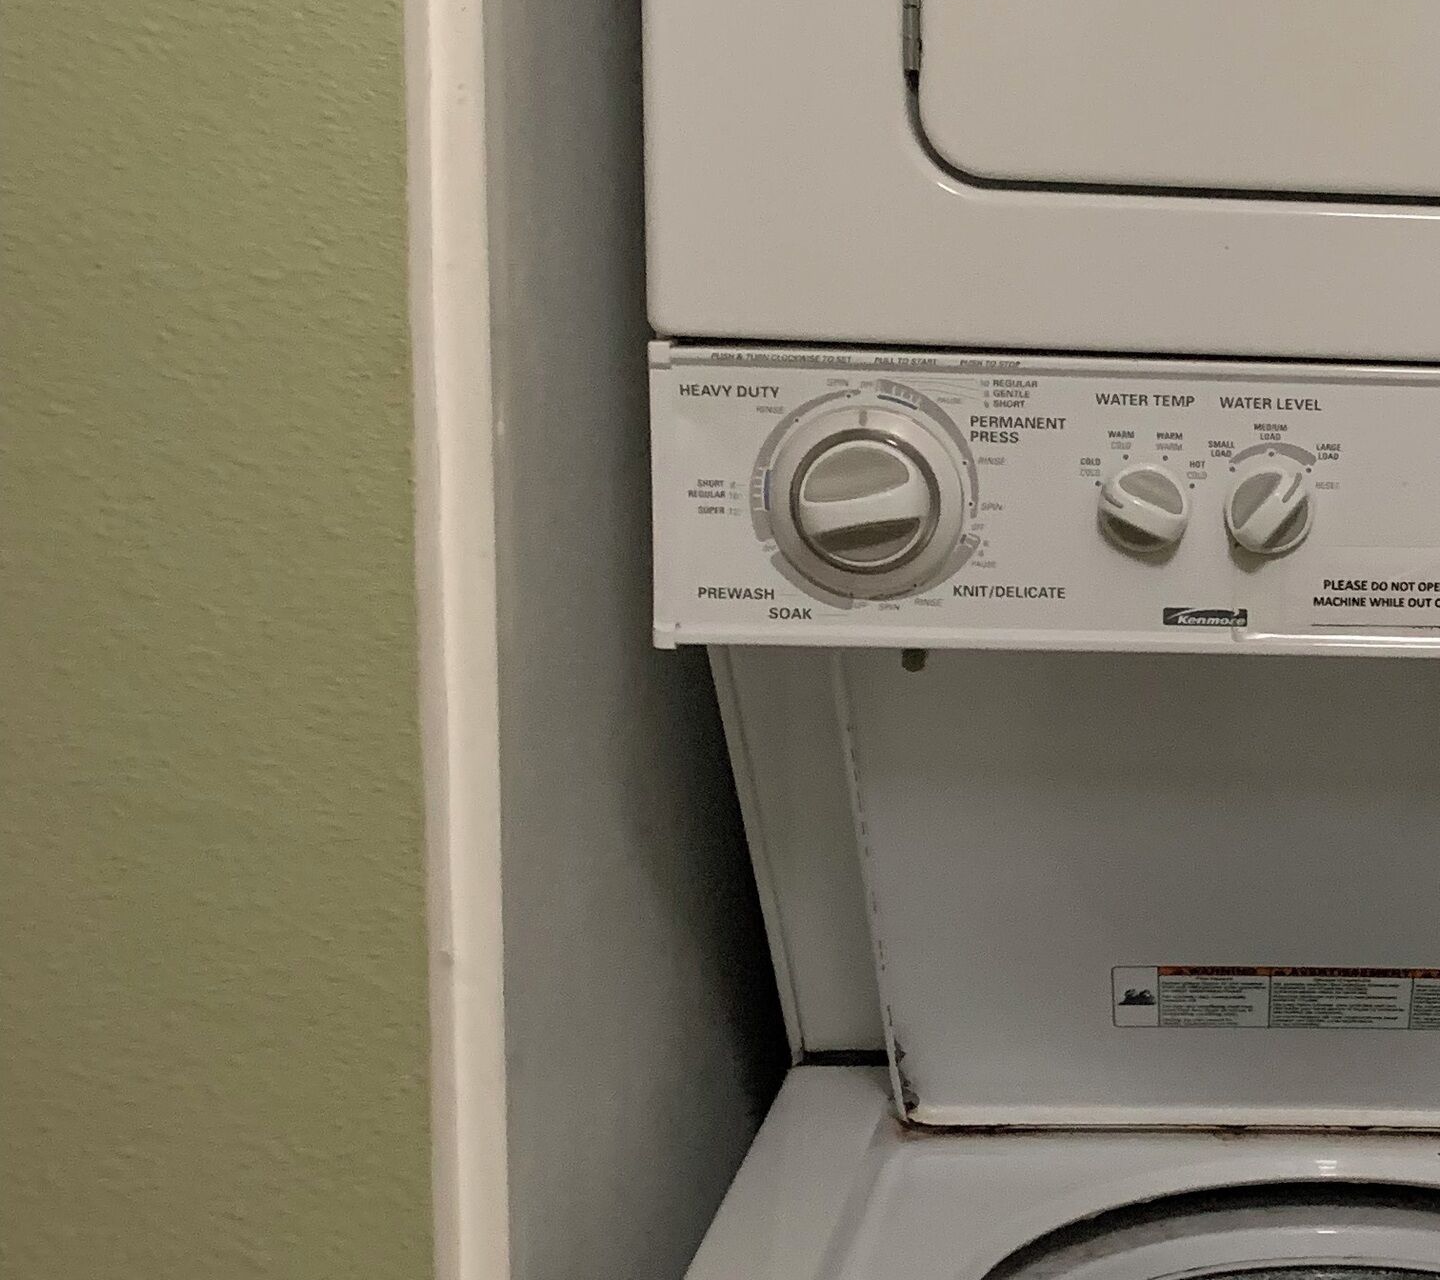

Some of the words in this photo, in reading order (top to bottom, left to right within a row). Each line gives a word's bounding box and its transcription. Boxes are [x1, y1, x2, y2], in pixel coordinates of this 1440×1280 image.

[911, 357, 937, 366] START
[993, 380, 1038, 388] REGULAR
[679, 384, 732, 397] HEAVY
[737, 385, 779, 398] DUTY
[993, 390, 1030, 398] GENTLE
[993, 399, 1025, 408] SHORT
[1095, 393, 1148, 407] WATER
[1153, 395, 1196, 408] TEMP
[1219, 397, 1272, 410] WATER
[1276, 398, 1322, 411] LEVEL
[970, 415, 1067, 430] PERMANENT
[1254, 423, 1288, 432] MEDIUM
[970, 430, 1019, 443] PRESS
[1107, 430, 1135, 439] WARM
[1156, 431, 1183, 440] WARM
[1259, 433, 1282, 441] LOAD
[1208, 440, 1235, 449] SMALL
[1315, 443, 1341, 452] LARGE
[1210, 449, 1232, 458] LOAD
[1317, 452, 1340, 461] LOAD
[1080, 458, 1101, 467] COLD
[1189, 460, 1206, 469] HOT
[697, 479, 724, 488] SHORT
[687, 489, 725, 498] REGULAR
[698, 506, 725, 515] SUPER
[1323, 579, 1368, 591] PLEASE
[1371, 581, 1388, 591] DO
[1391, 581, 1415, 592] NOT
[697, 586, 775, 600] PREWASH
[952, 585, 1066, 599] KNIT/DELICATE
[1313, 596, 1366, 607] MACHINE
[1369, 597, 1405, 607] WHILE
[1408, 598, 1432, 608] OUT
[768, 607, 812, 620] SOAK
[1177, 615, 1246, 626] Kenmore
